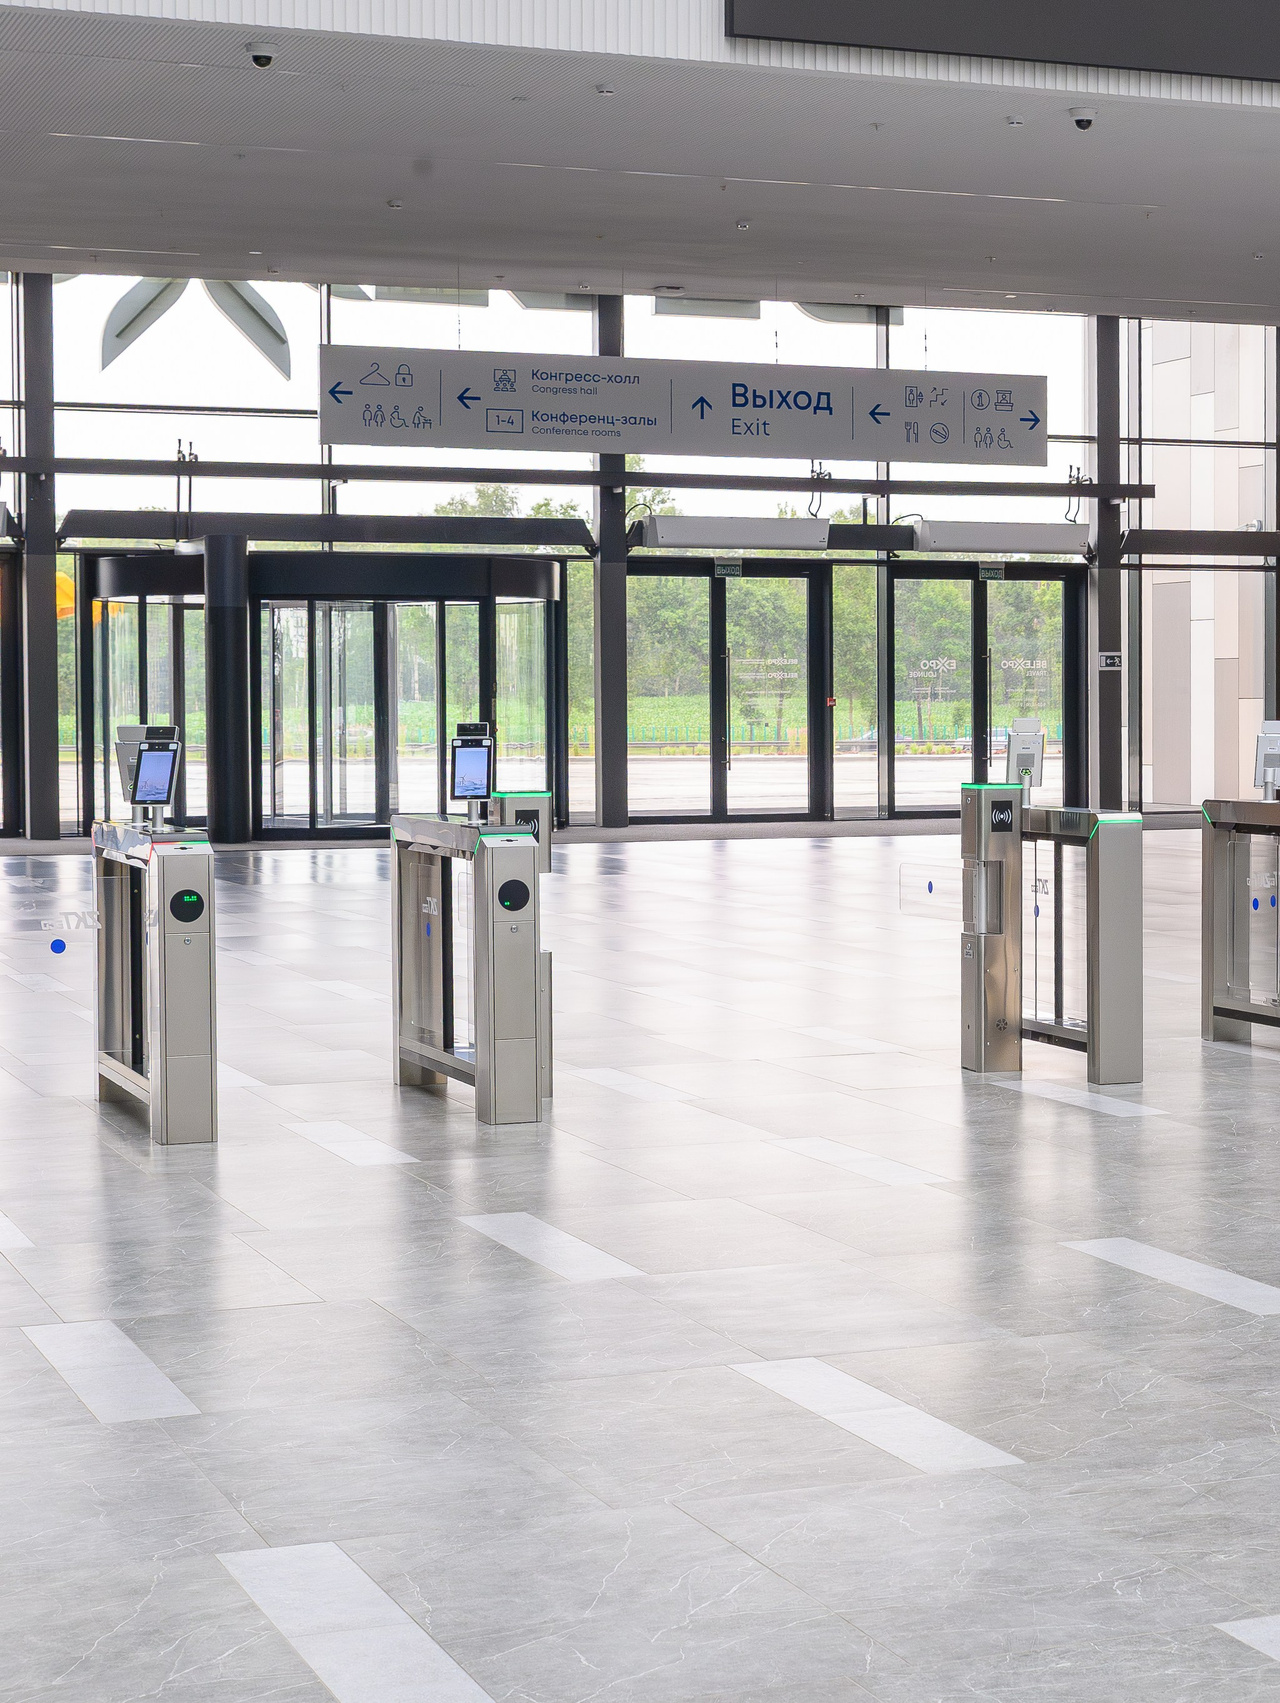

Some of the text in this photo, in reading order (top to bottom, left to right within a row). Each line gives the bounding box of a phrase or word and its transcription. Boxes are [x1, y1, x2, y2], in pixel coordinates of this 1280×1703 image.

[531, 368, 640, 385] Конгресс-холл
[532, 385, 598, 396] Congress hall
[731, 383, 833, 415] Выход
[496, 414, 515, 427] 1-4
[531, 410, 657, 427] Конференц-залы
[531, 426, 622, 438] Conference rooms
[731, 418, 770, 436] Exit
[716, 566, 740, 575] ВЫХОД
[981, 569, 1003, 578] ВЫХОД
